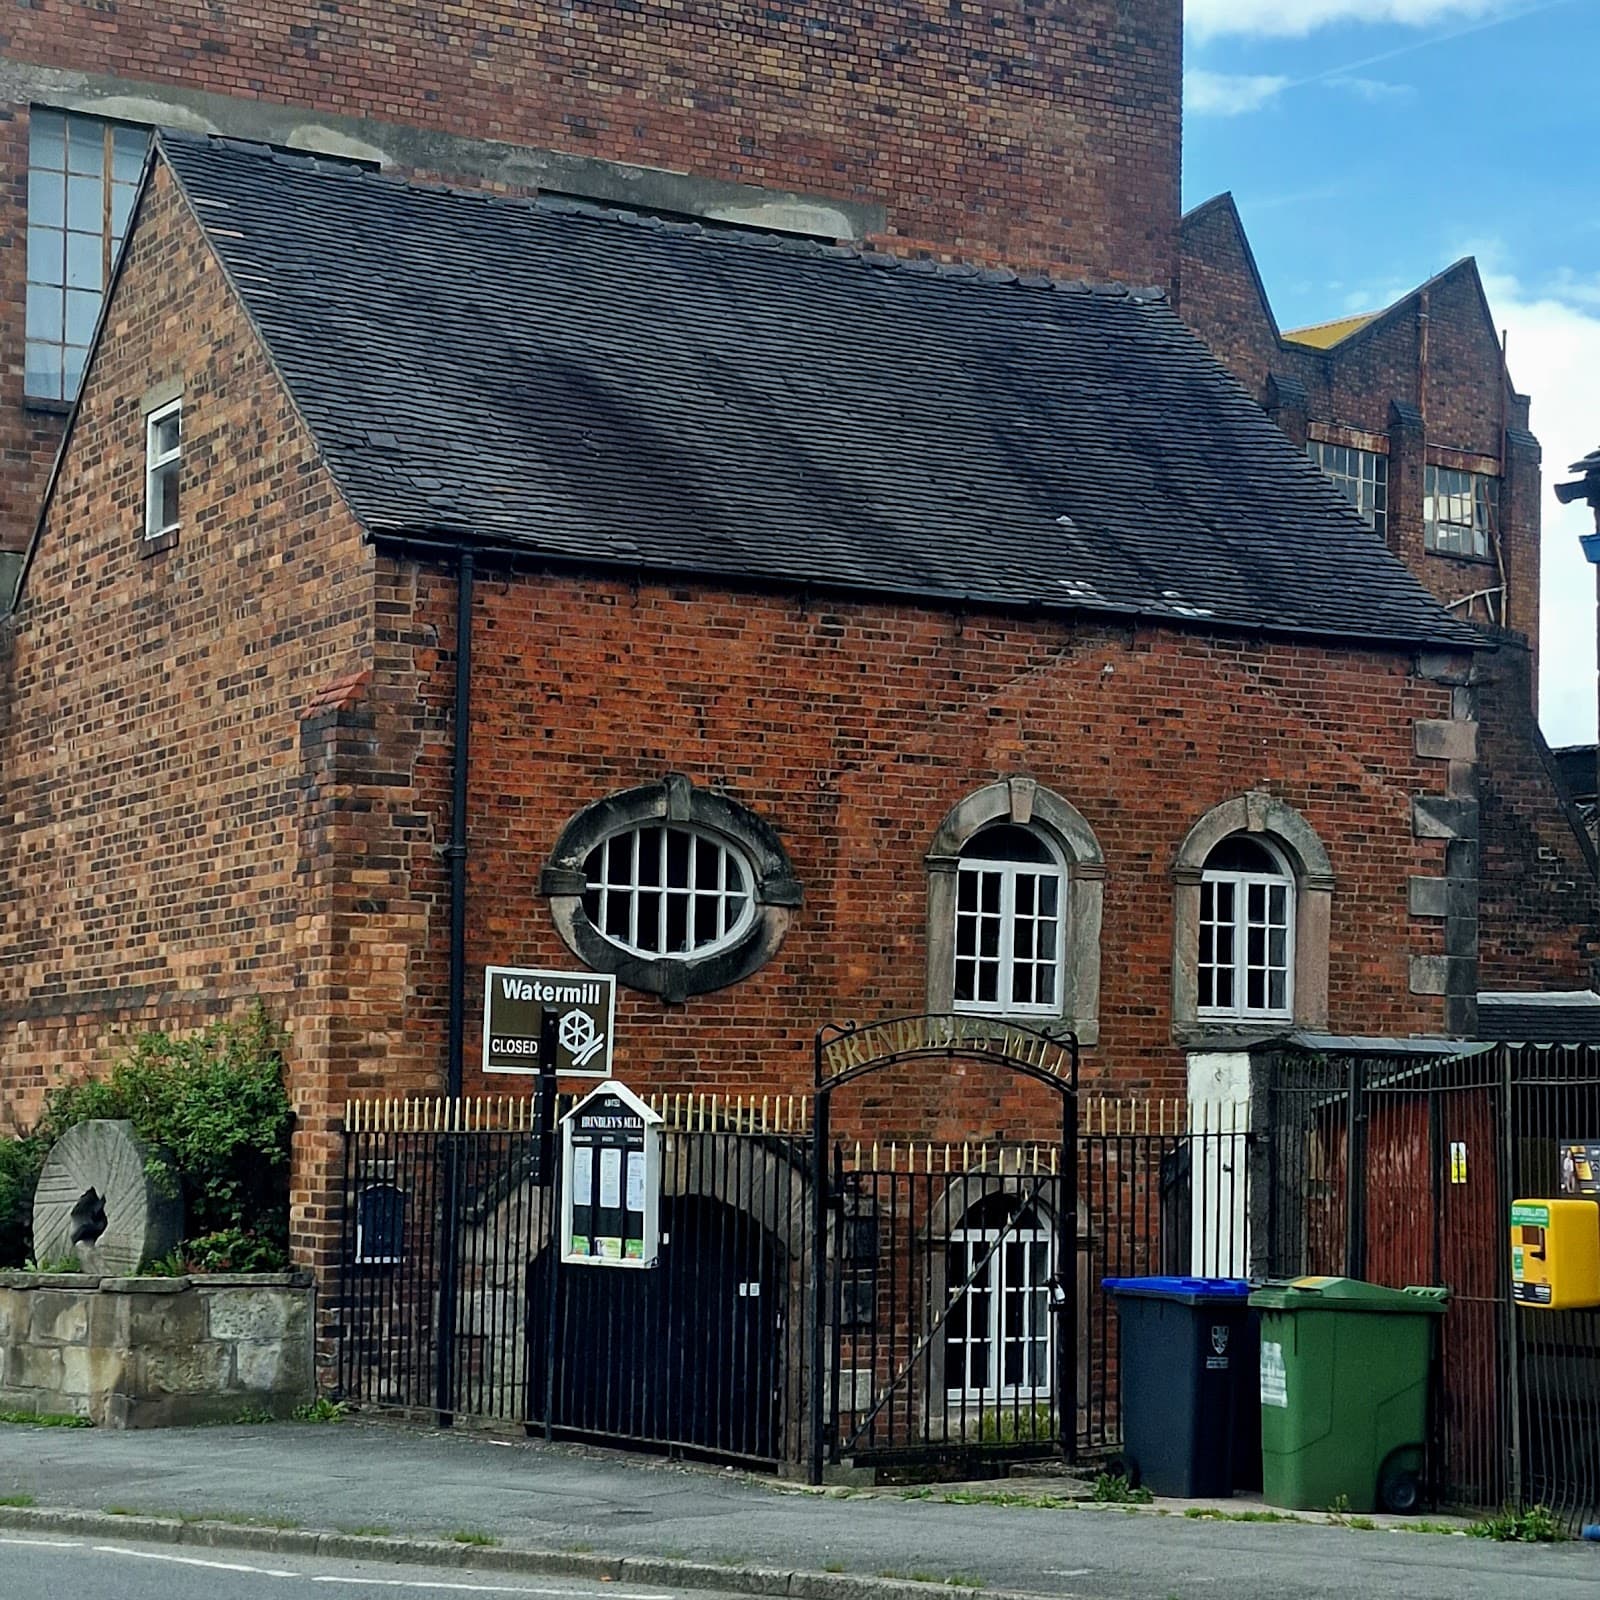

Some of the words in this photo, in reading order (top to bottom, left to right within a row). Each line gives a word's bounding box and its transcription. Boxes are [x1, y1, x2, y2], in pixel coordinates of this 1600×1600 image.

[502, 978, 600, 1005] Watermill
[491, 1039, 538, 1054] CLOSED
[1002, 1029, 1072, 1080] MILL
[623, 1116, 644, 1129] MILL
